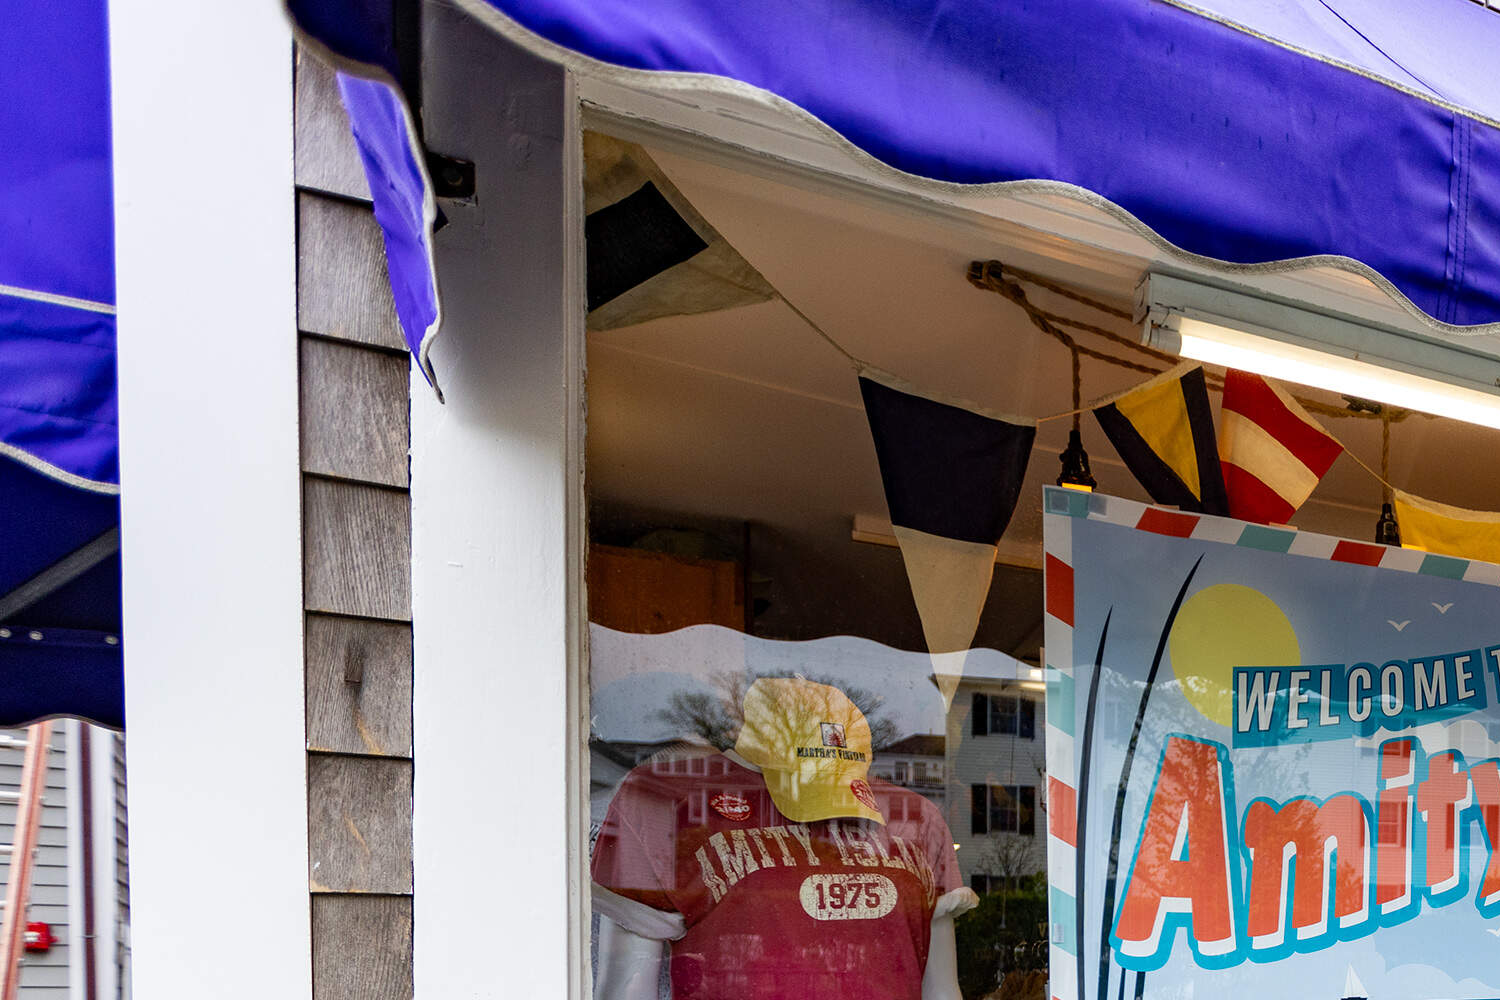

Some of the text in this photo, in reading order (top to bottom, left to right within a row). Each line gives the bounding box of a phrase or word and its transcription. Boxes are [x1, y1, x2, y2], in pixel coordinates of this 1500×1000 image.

[1236, 652, 1477, 734] WELCOME
[694, 824, 821, 904] AMITY
[815, 883, 881, 910] 1975
